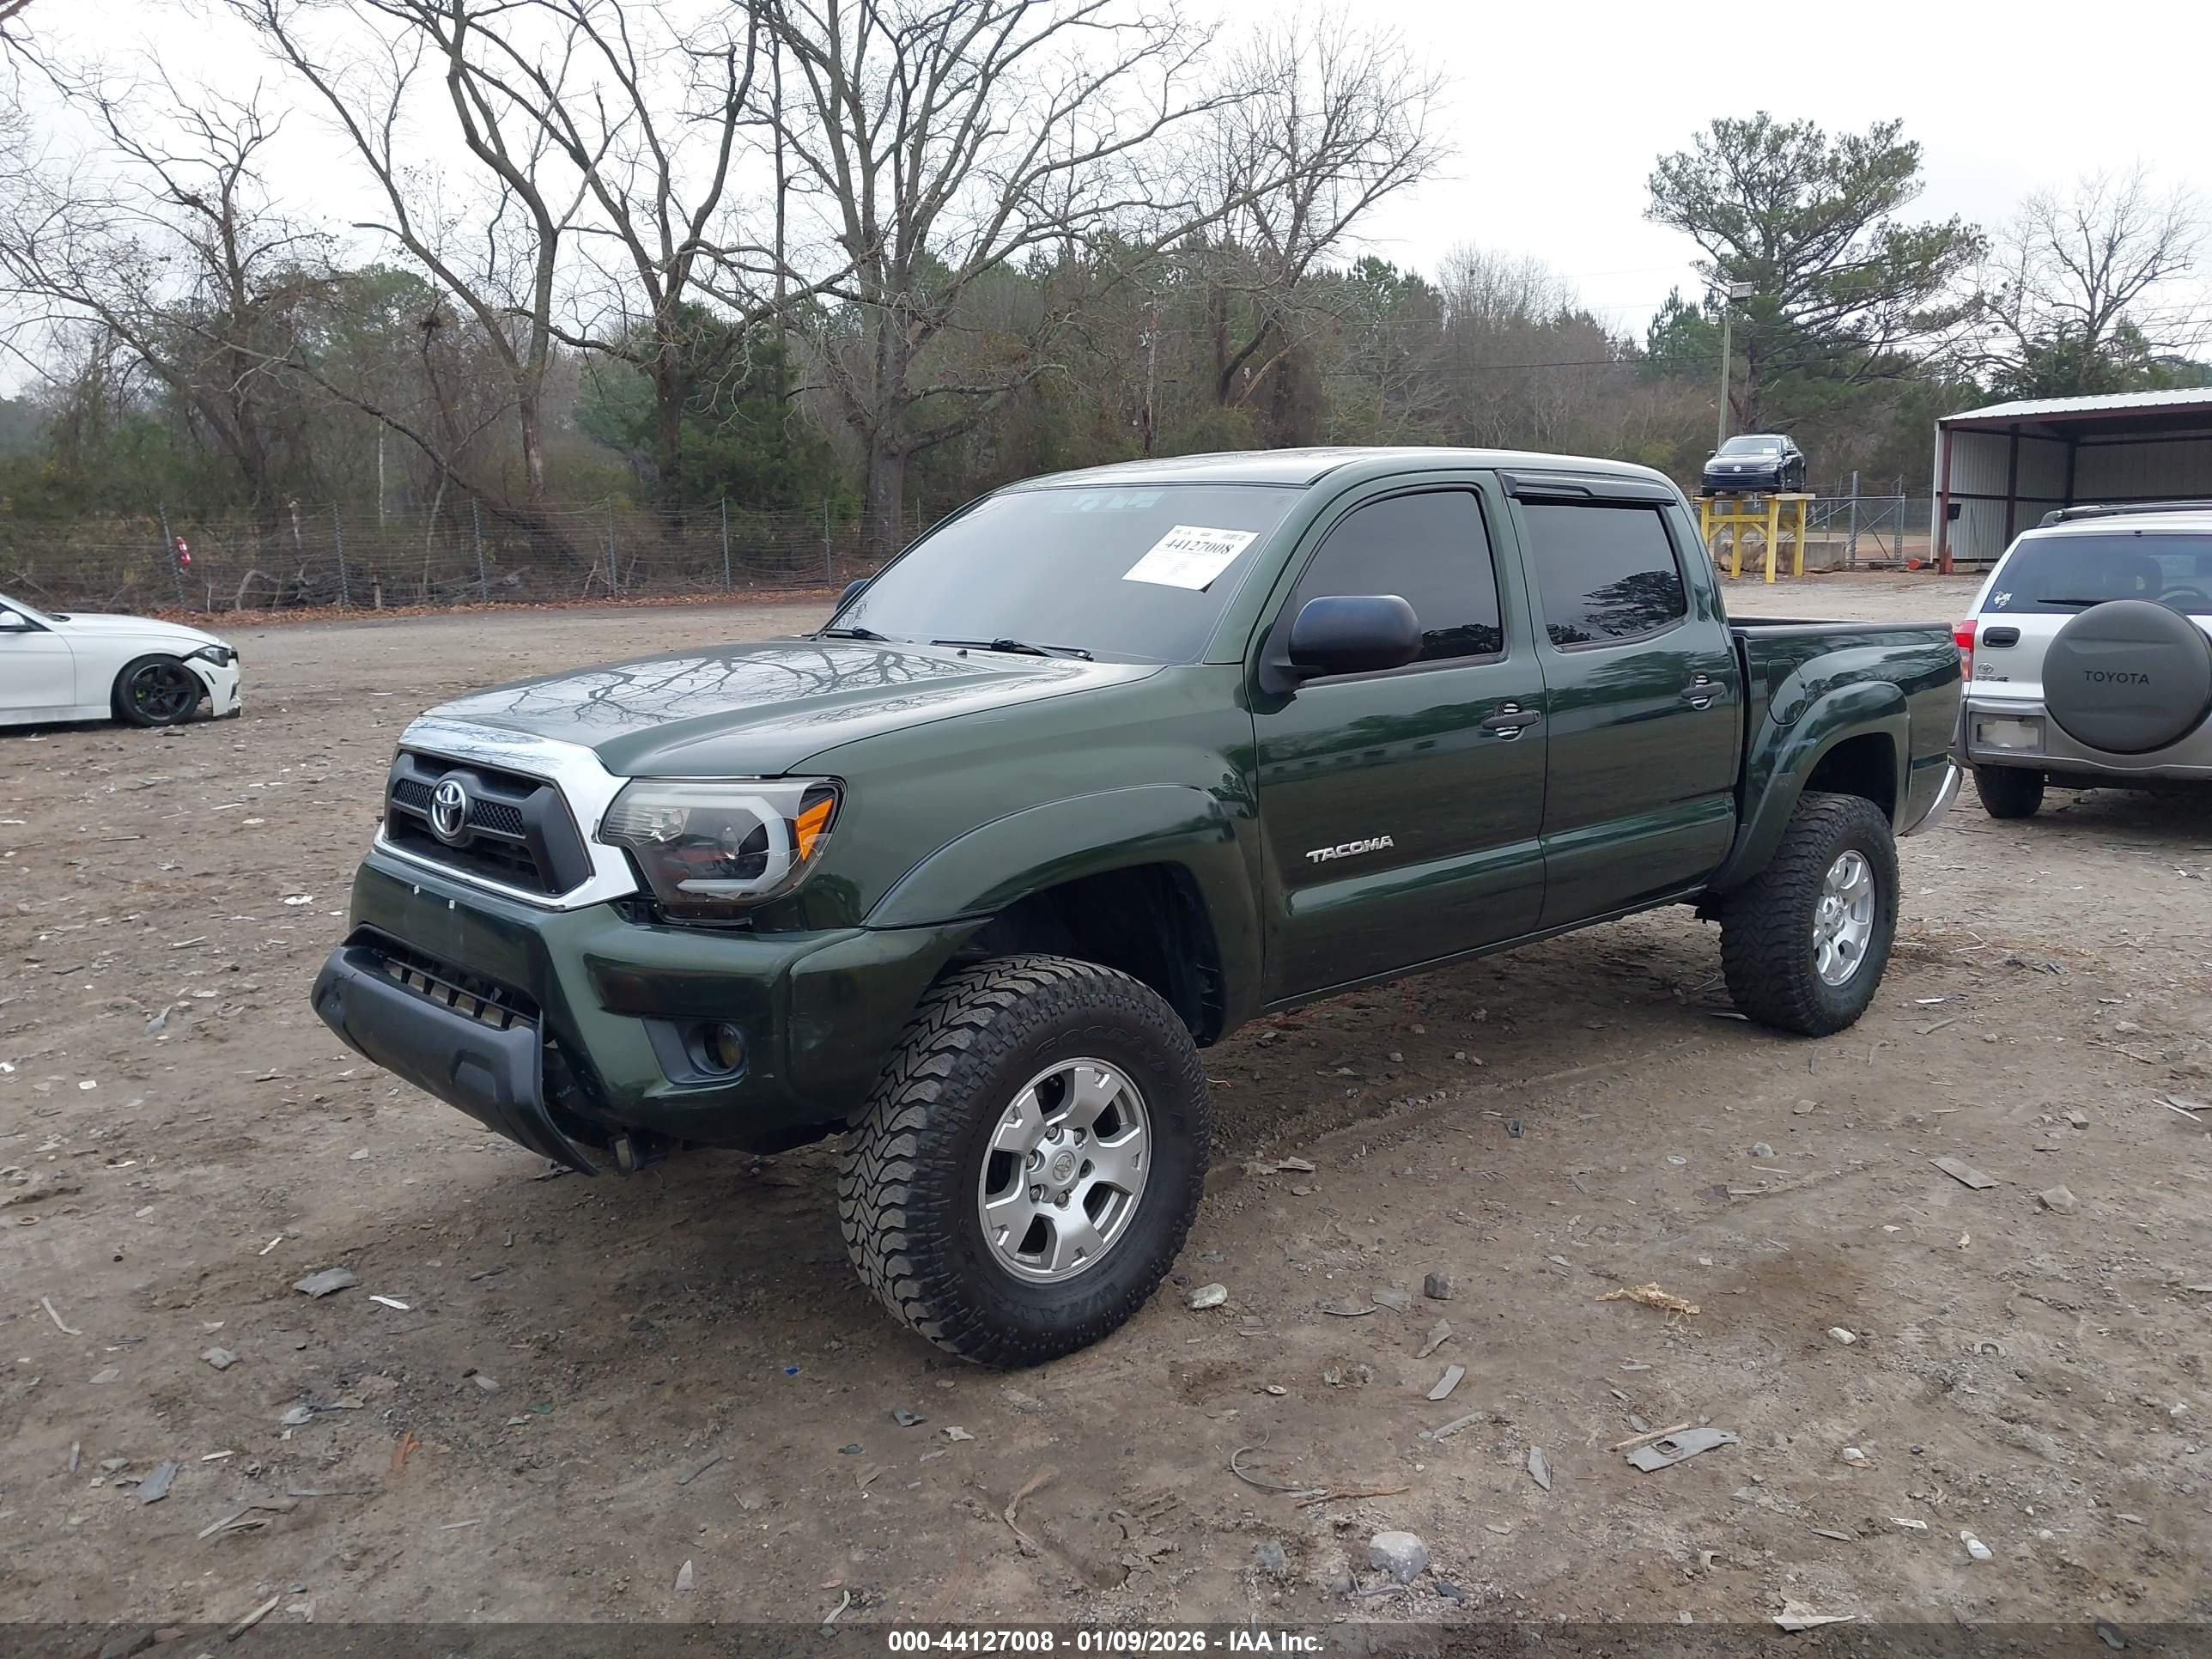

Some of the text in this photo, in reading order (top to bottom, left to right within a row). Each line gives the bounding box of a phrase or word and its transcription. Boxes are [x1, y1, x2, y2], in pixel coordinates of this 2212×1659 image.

[1165, 538, 1235, 555] 44127008
[2084, 670, 2149, 685] TOYOTA
[1305, 835, 1395, 864] TACOMA
